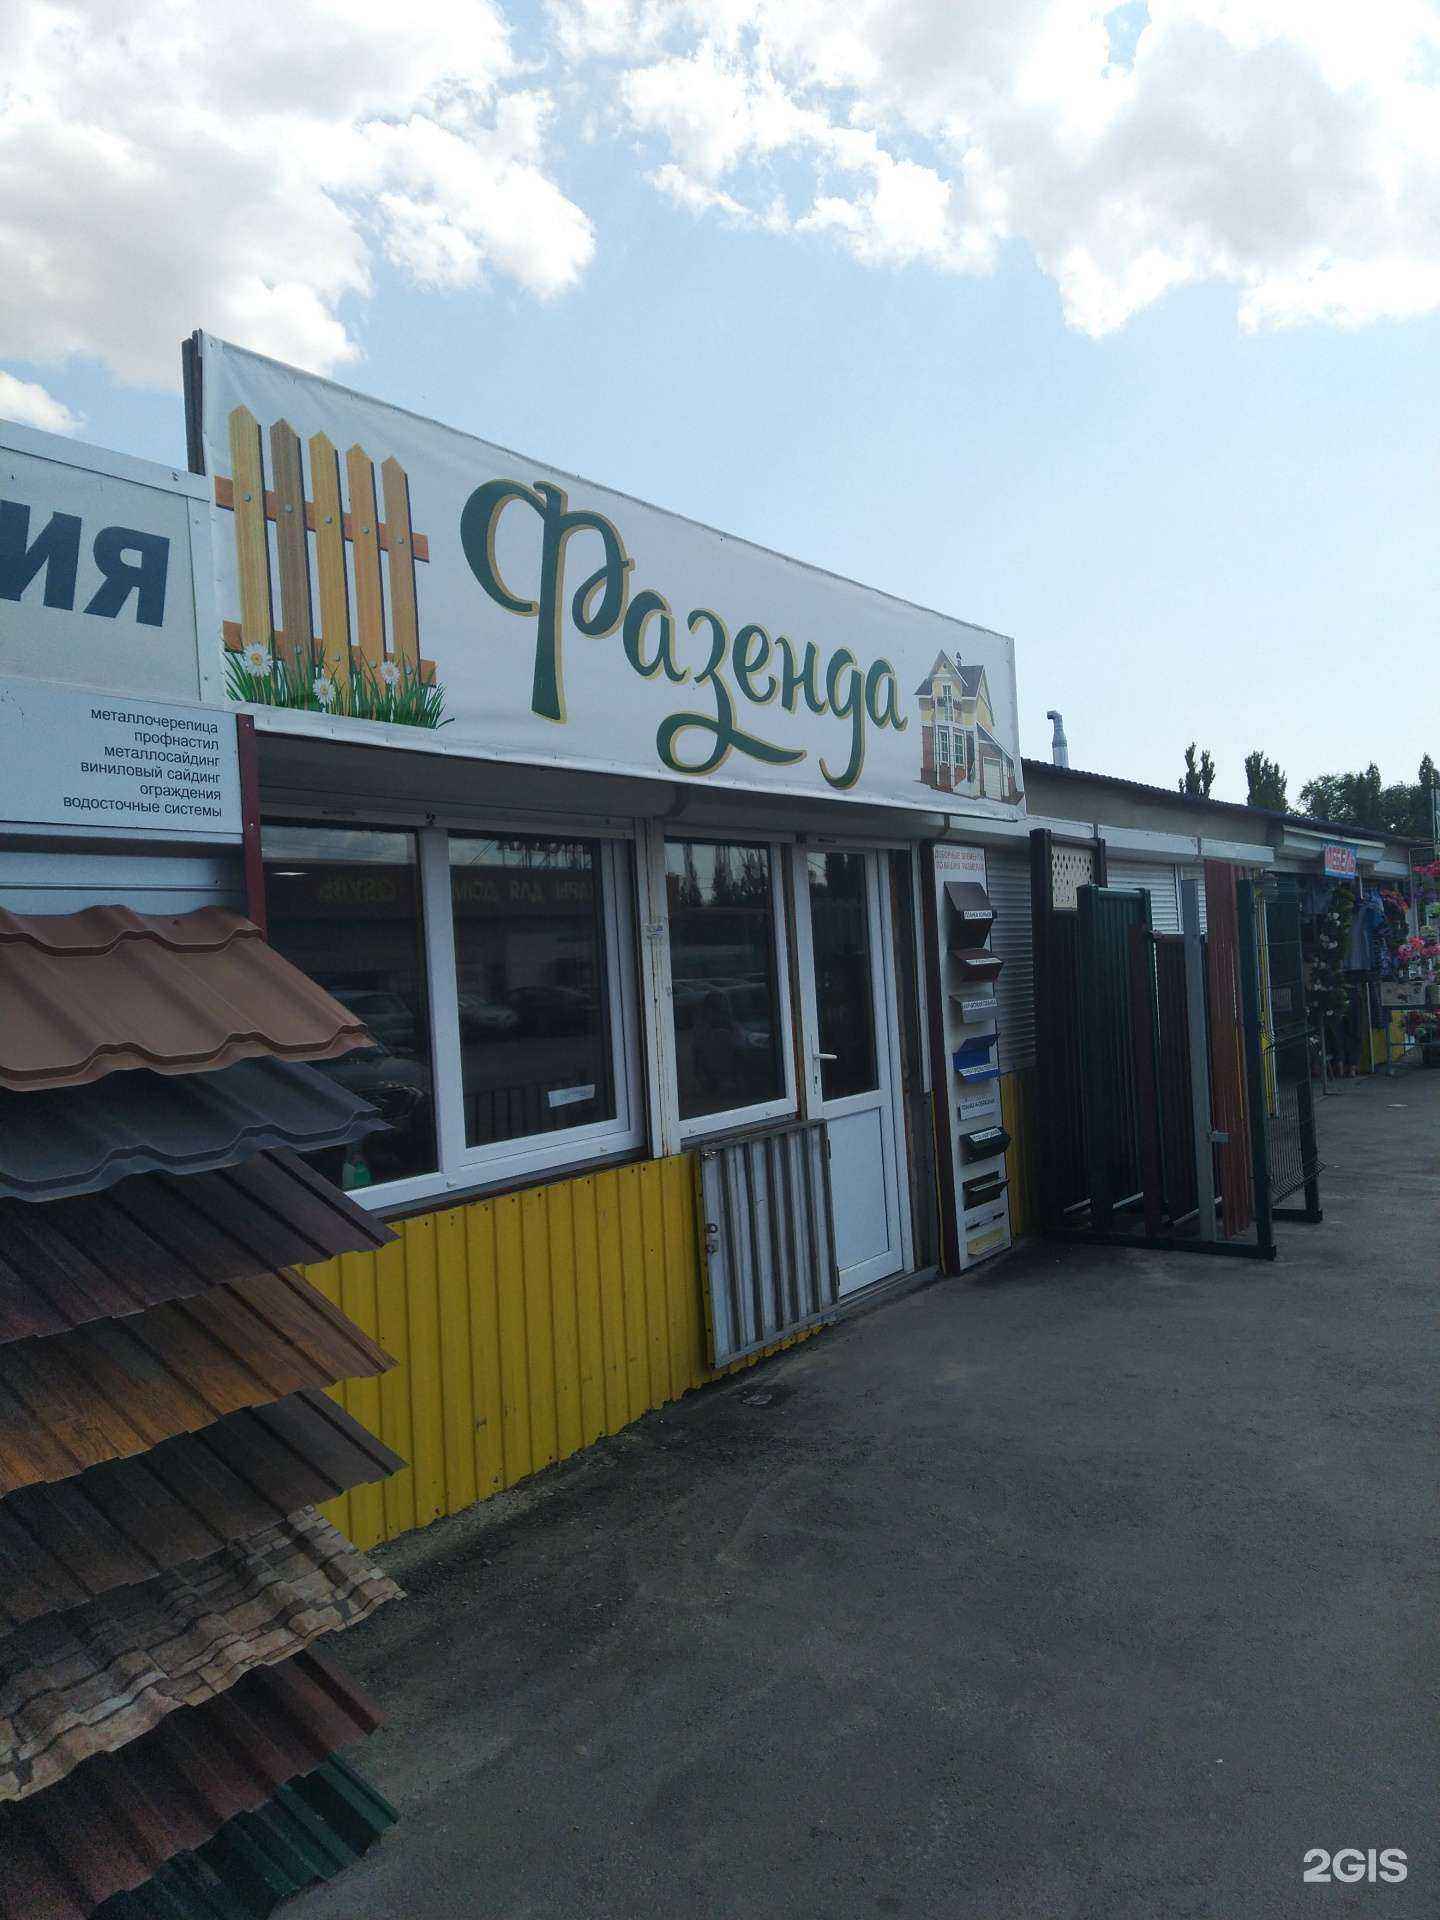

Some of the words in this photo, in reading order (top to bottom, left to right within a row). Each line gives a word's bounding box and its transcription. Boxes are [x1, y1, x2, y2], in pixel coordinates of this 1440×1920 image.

[460, 478, 907, 790] Фазенда
[90, 708, 218, 734] металлочерепица
[134, 730, 219, 751] профнастил
[104, 746, 220, 767] металлосайдинг
[81, 761, 163, 779] виниловый
[167, 768, 221, 784] сайдинг
[139, 784, 221, 801] ограждения
[63, 796, 160, 813] водосточные
[164, 803, 222, 818] системы
